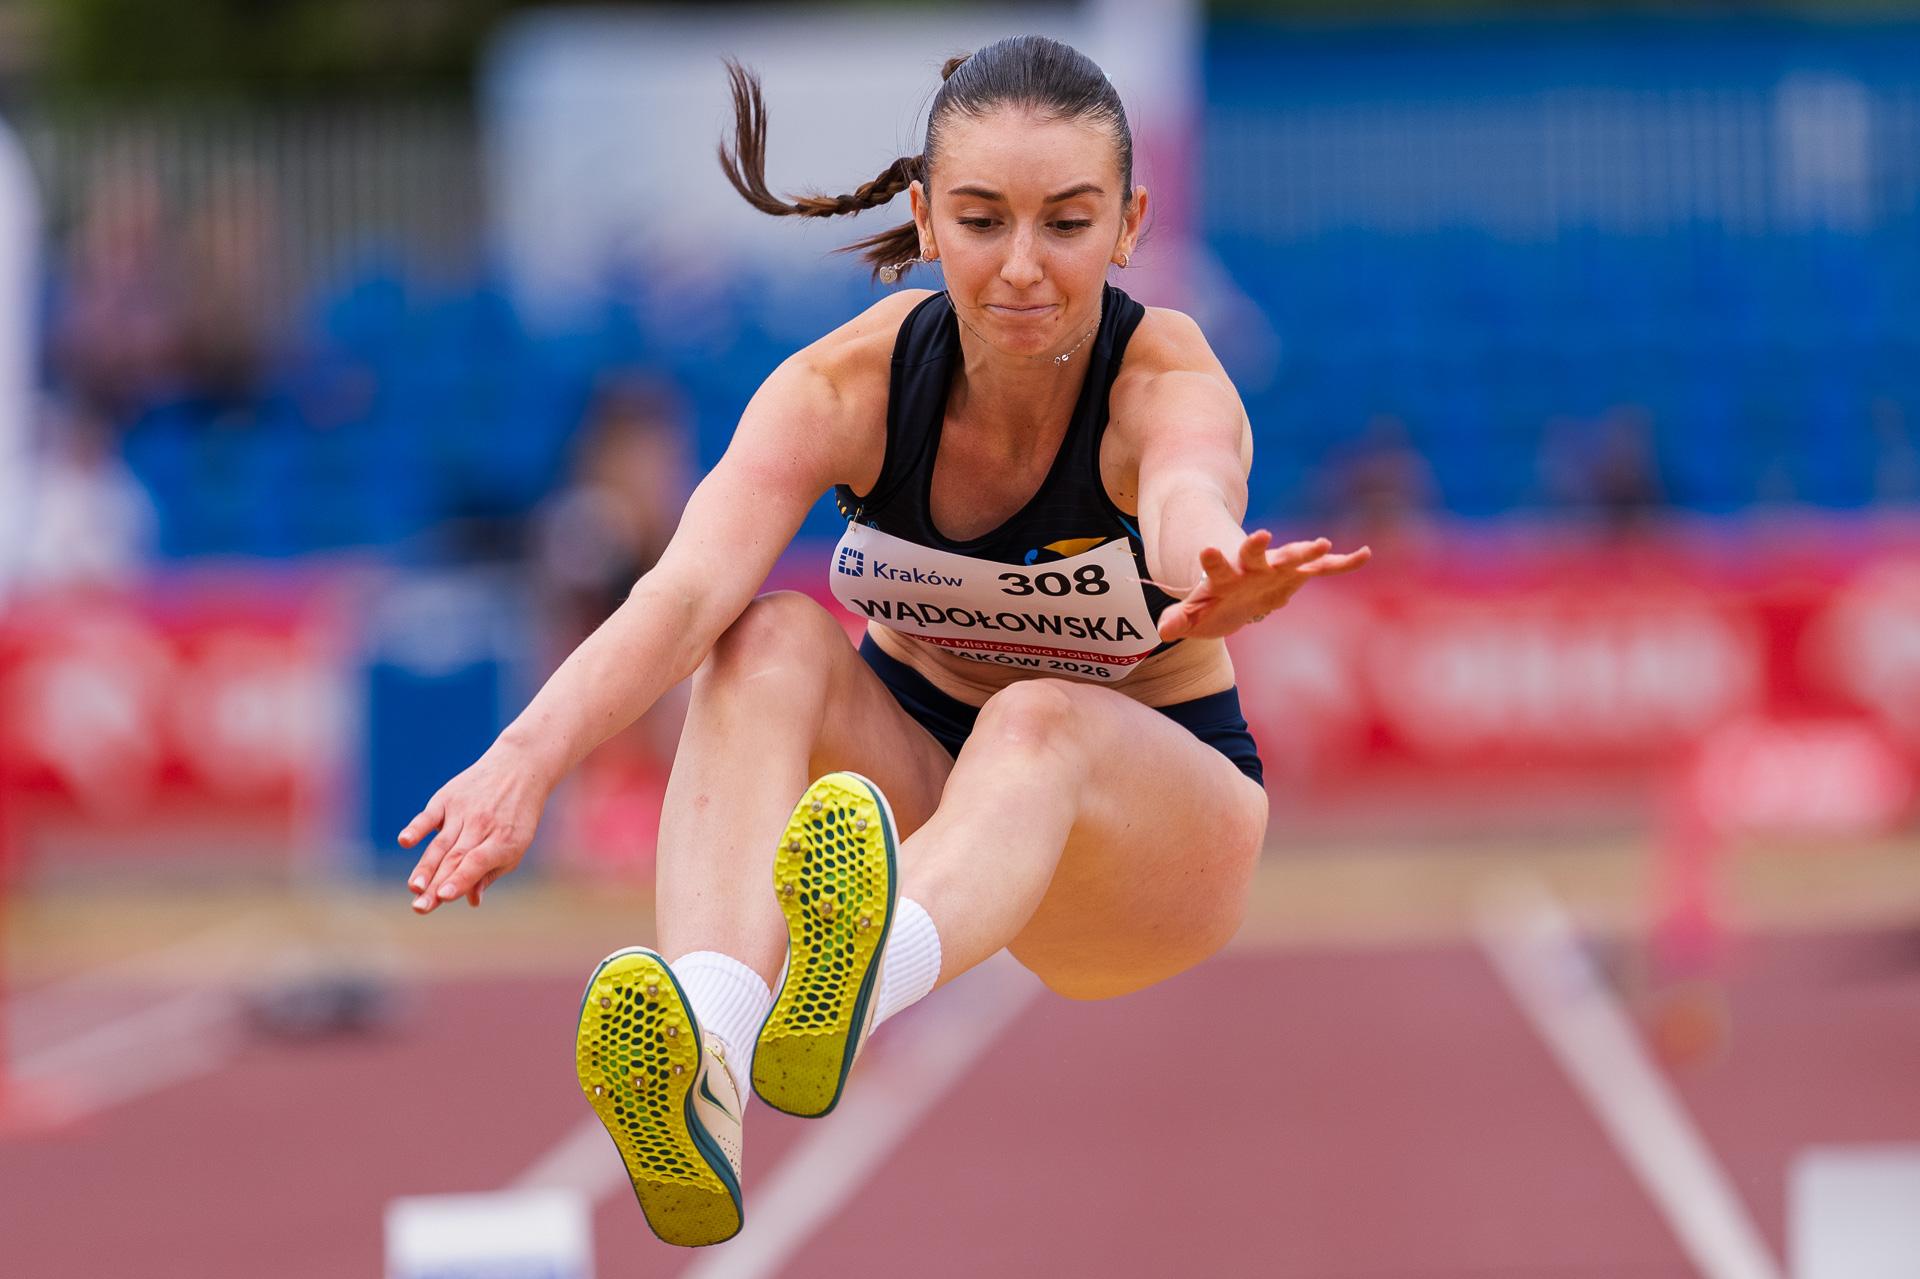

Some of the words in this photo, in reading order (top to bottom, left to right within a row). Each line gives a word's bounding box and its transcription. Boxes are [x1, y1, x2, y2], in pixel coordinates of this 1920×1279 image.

[874, 560, 963, 587] Kraków
[998, 564, 1110, 597] 308
[850, 599, 1144, 642] WĄDOŁOWSKA
[955, 640, 1053, 656] Mistrzostwa
[1056, 650, 1104, 662] Polski
[1107, 656, 1139, 665] U23
[1047, 660, 1111, 678] 2026
